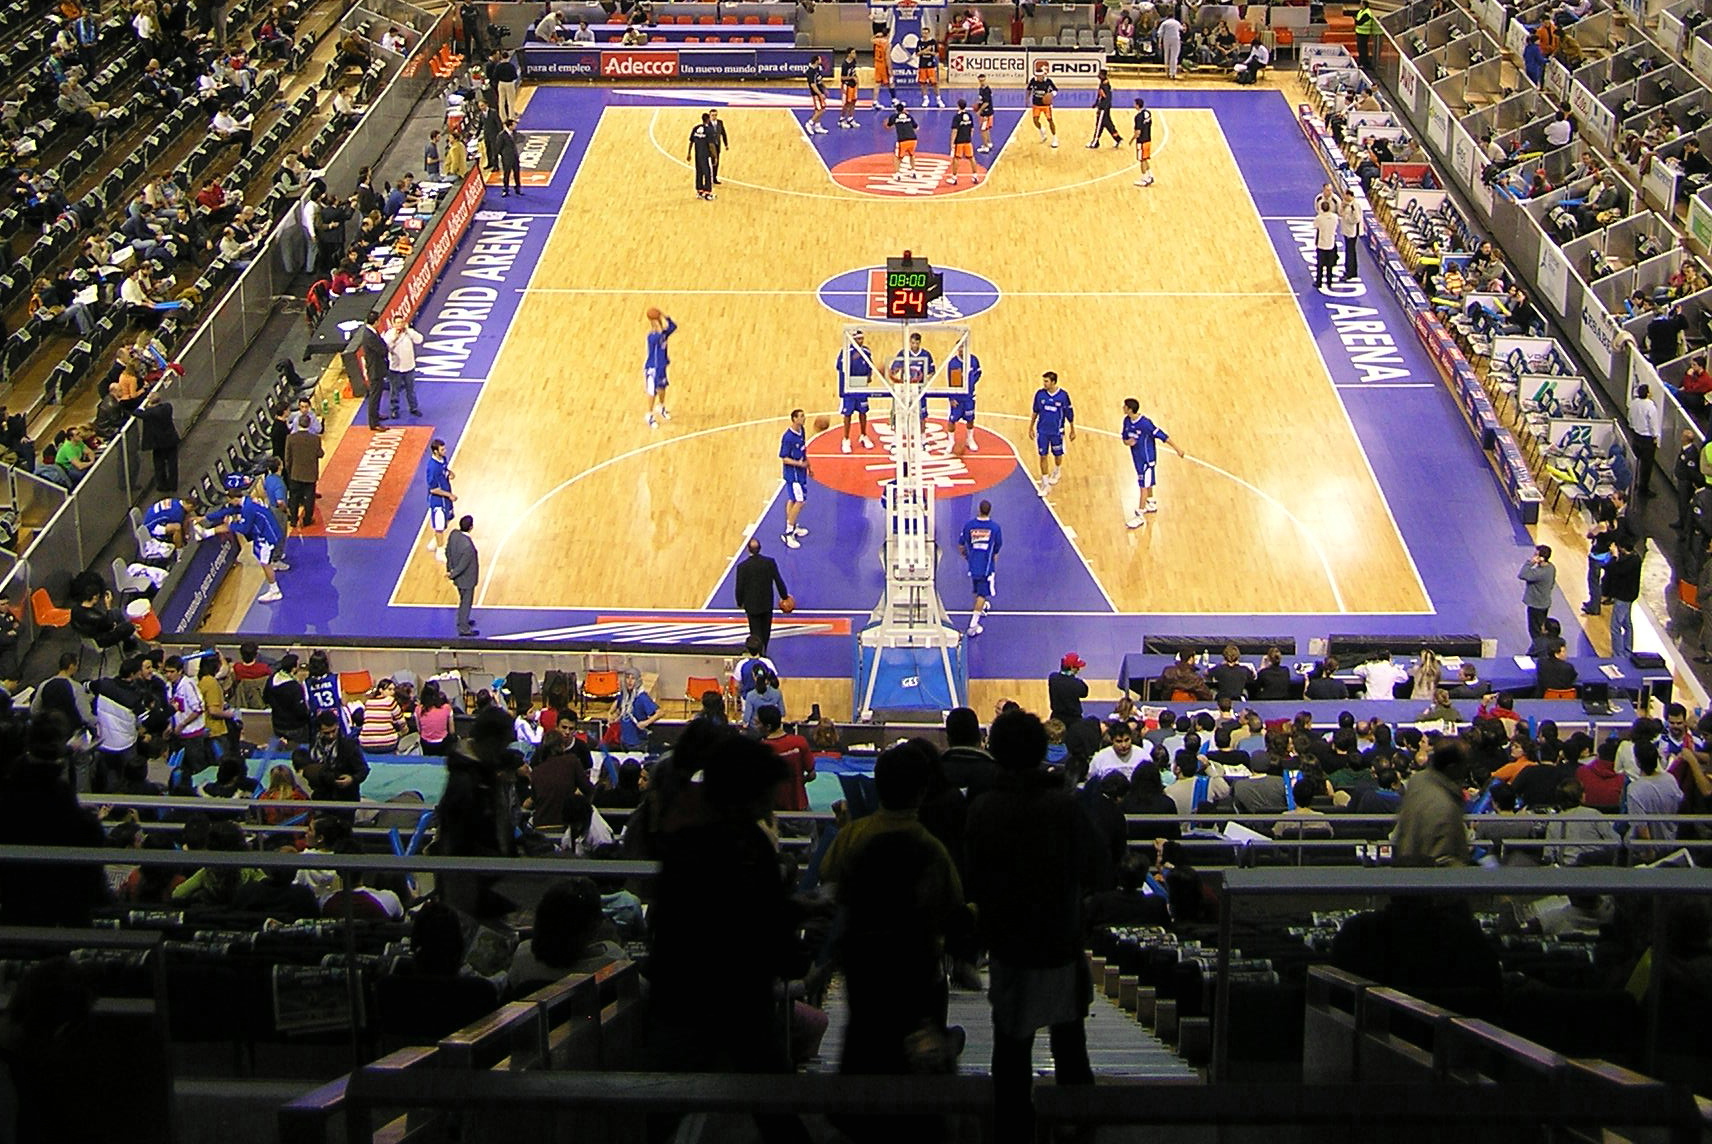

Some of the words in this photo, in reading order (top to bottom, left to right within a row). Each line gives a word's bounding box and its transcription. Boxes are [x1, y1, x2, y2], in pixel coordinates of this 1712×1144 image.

[526, 64, 548, 74] para
[549, 62, 558, 72] el
[558, 63, 591, 74] empleo
[604, 56, 676, 75] Adecco
[681, 64, 694, 74] Un
[695, 66, 722, 74] nuevo
[724, 64, 756, 74] mundo
[758, 64, 778, 74] para
[779, 62, 788, 72] el
[966, 57, 1025, 71] KYOCERA
[1051, 63, 1097, 74] AND1
[407, 263, 431, 305] Adecco
[428, 230, 449, 271] Adecco
[448, 200, 468, 241] Adecco
[465, 173, 484, 209] Adecco
[889, 274, 926, 287] 08:00
[415, 286, 499, 378] MADRID
[460, 216, 534, 283] ARENA
[892, 290, 923, 315] 24
[1325, 303, 1411, 383] ARENA
[313, 690, 335, 707] 13
